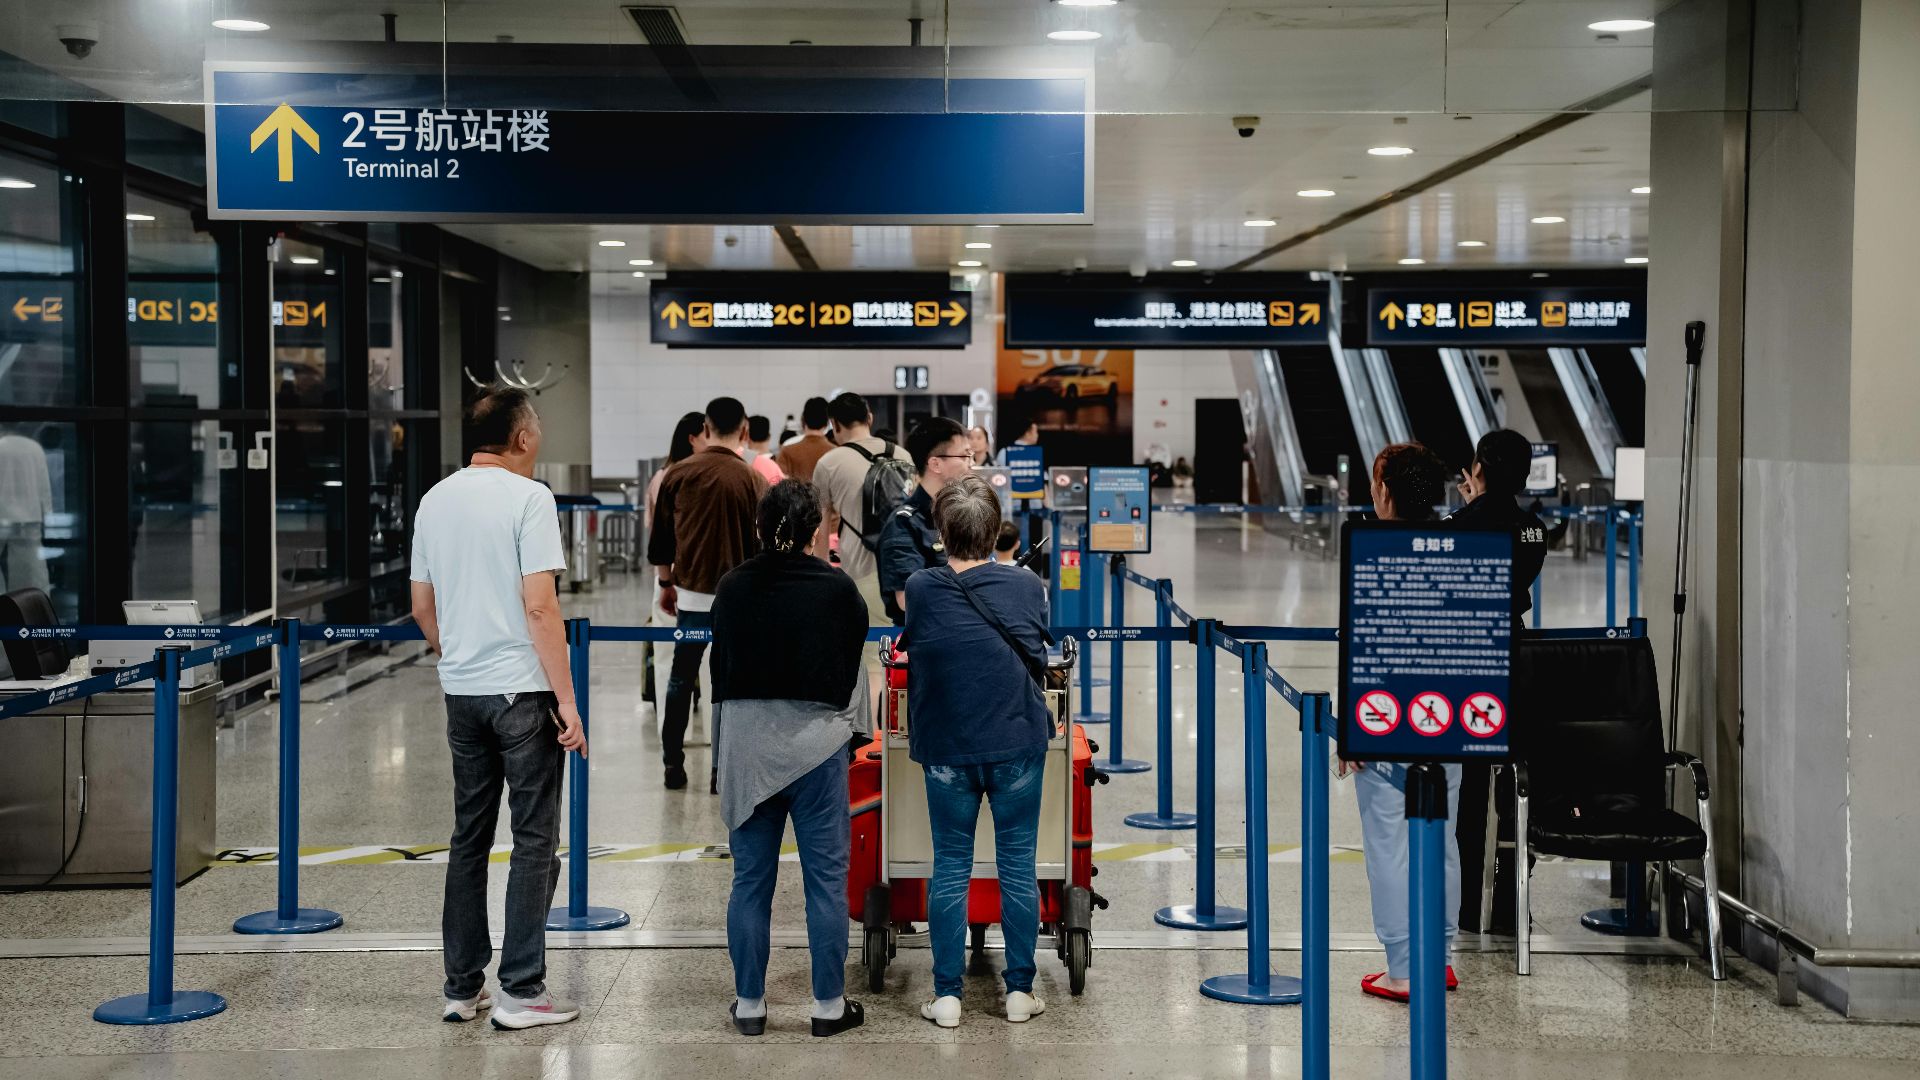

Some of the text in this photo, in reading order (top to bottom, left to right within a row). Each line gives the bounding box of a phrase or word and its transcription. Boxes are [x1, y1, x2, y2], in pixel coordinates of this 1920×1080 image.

[341, 107, 551, 154] 2号航站楼
[342, 156, 460, 180] Terminal 2
[713, 301, 774, 319] 国内到达
[773, 303, 806, 326] 2C
[818, 303, 852, 326] 2D
[852, 301, 914, 319] 国内到达
[1494, 300, 1527, 319] 出发
[1411, 537, 1456, 553] 告知书
